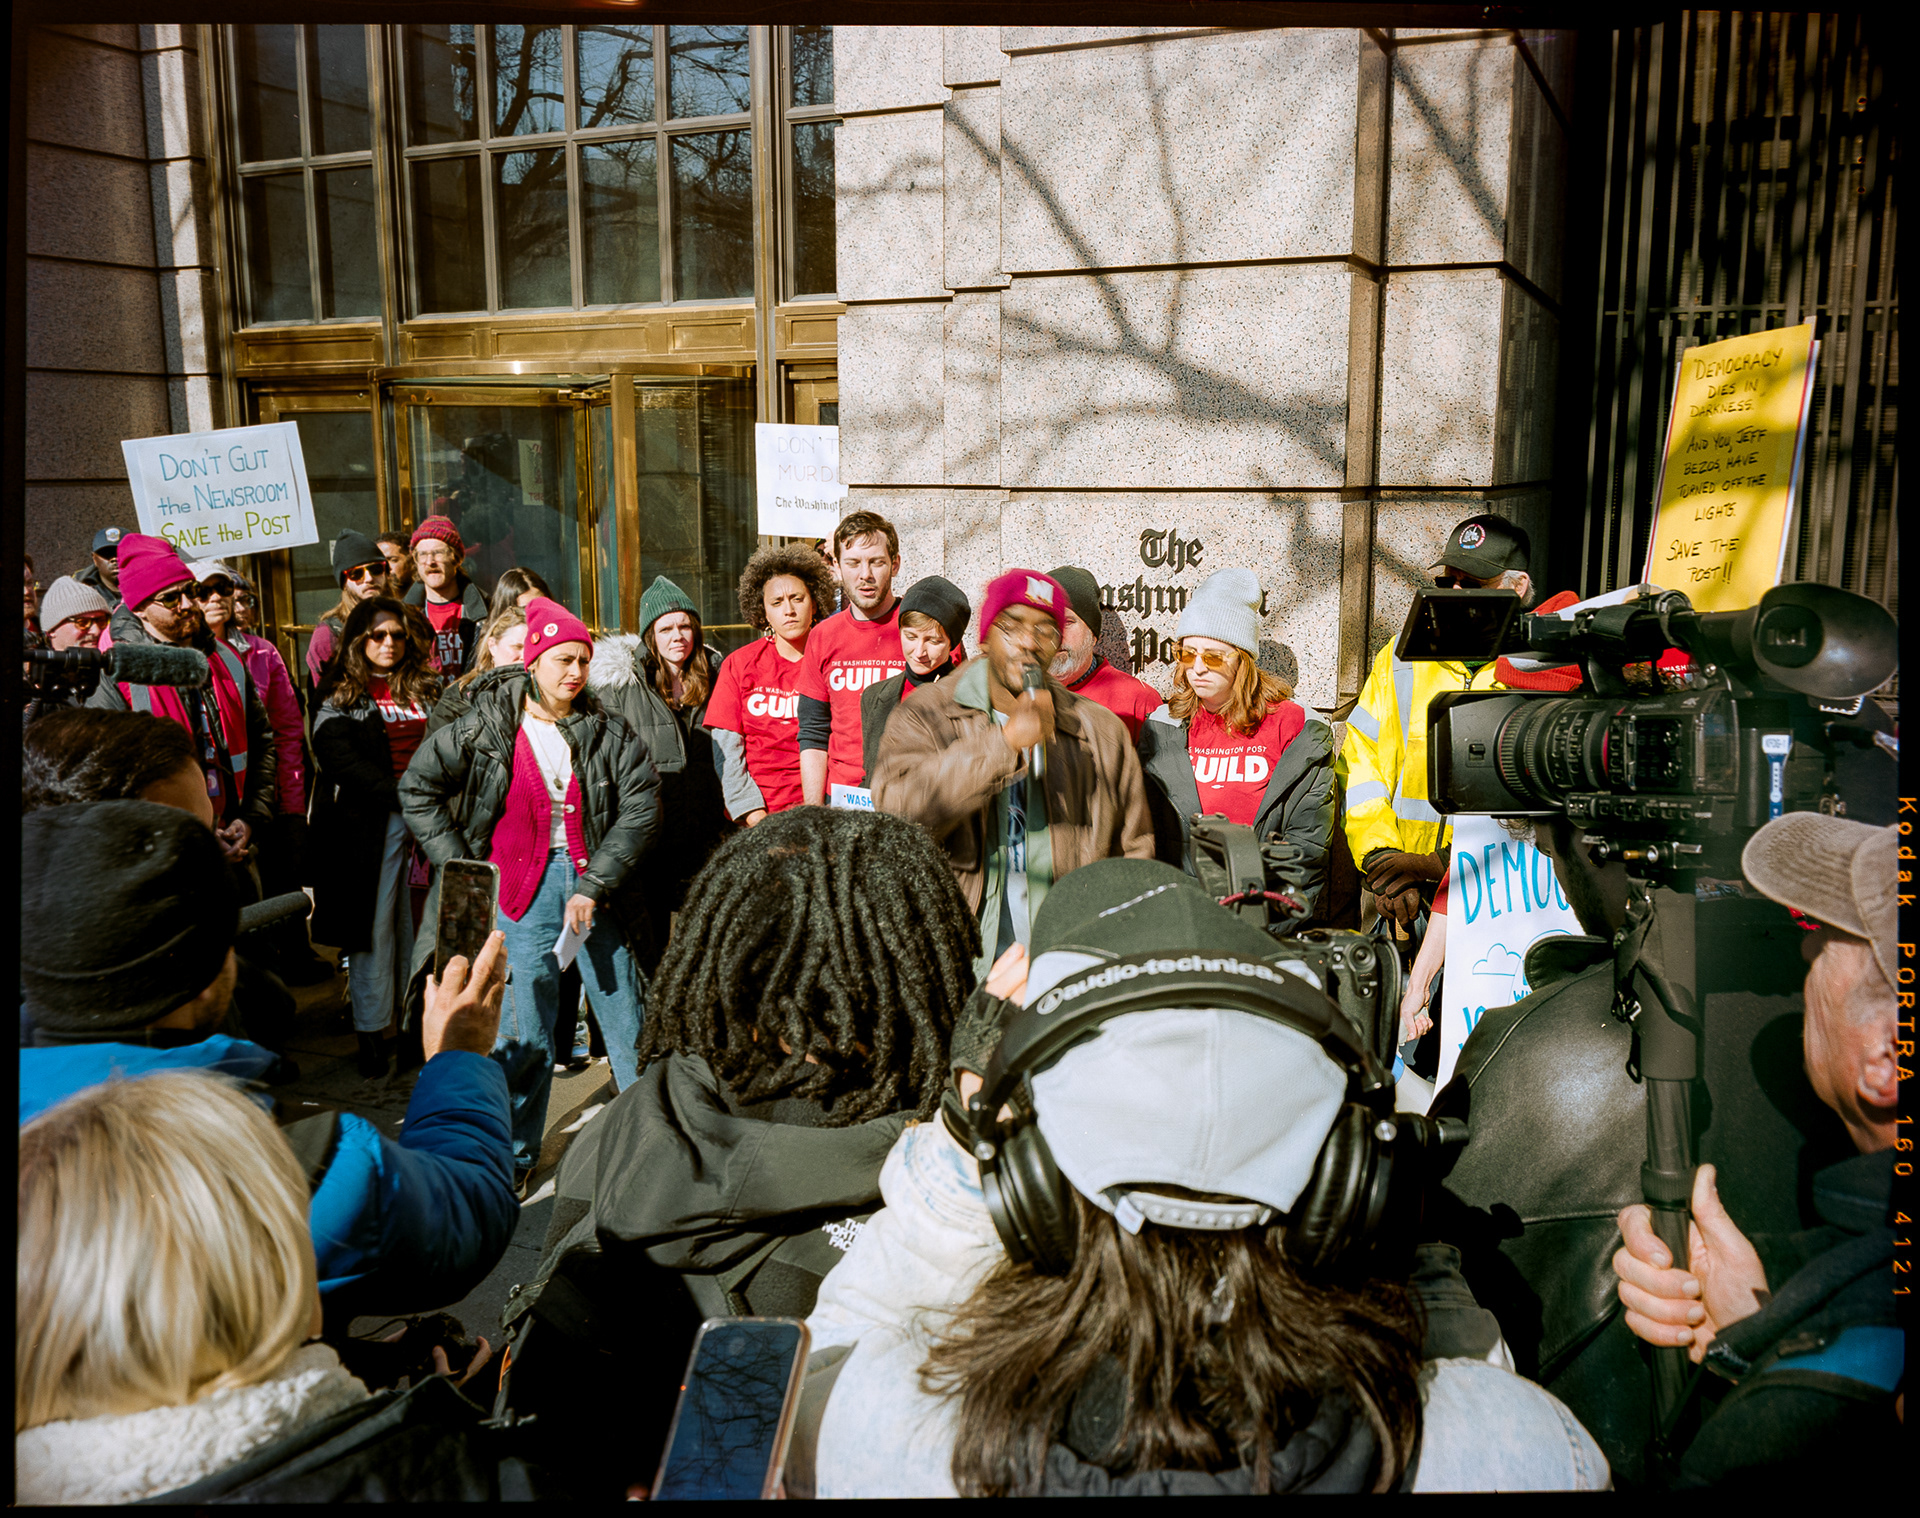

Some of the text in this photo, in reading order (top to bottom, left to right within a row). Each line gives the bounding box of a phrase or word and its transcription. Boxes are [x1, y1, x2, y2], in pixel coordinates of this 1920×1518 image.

[1707, 382, 1736, 399] DIES
[777, 436, 839, 454] DON'T
[1686, 435, 1709, 453] AND
[1736, 425, 1767, 444] JEFF
[159, 445, 269, 481] DON'T GUT
[1726, 451, 1759, 469] HAVE
[778, 464, 839, 483] MURD
[1677, 473, 1767, 498] TURNED OFF THE
[157, 482, 289, 516] the NEWSROOM
[775, 496, 792, 508] The
[161, 511, 292, 549] SAVE the POST
[1139, 527, 1204, 575] The
[1666, 538, 1740, 561] SAVE THE
[1194, 745, 1244, 755] WASHINGTON
[1246, 745, 1267, 753] POST
[1189, 755, 1269, 783] UILD
